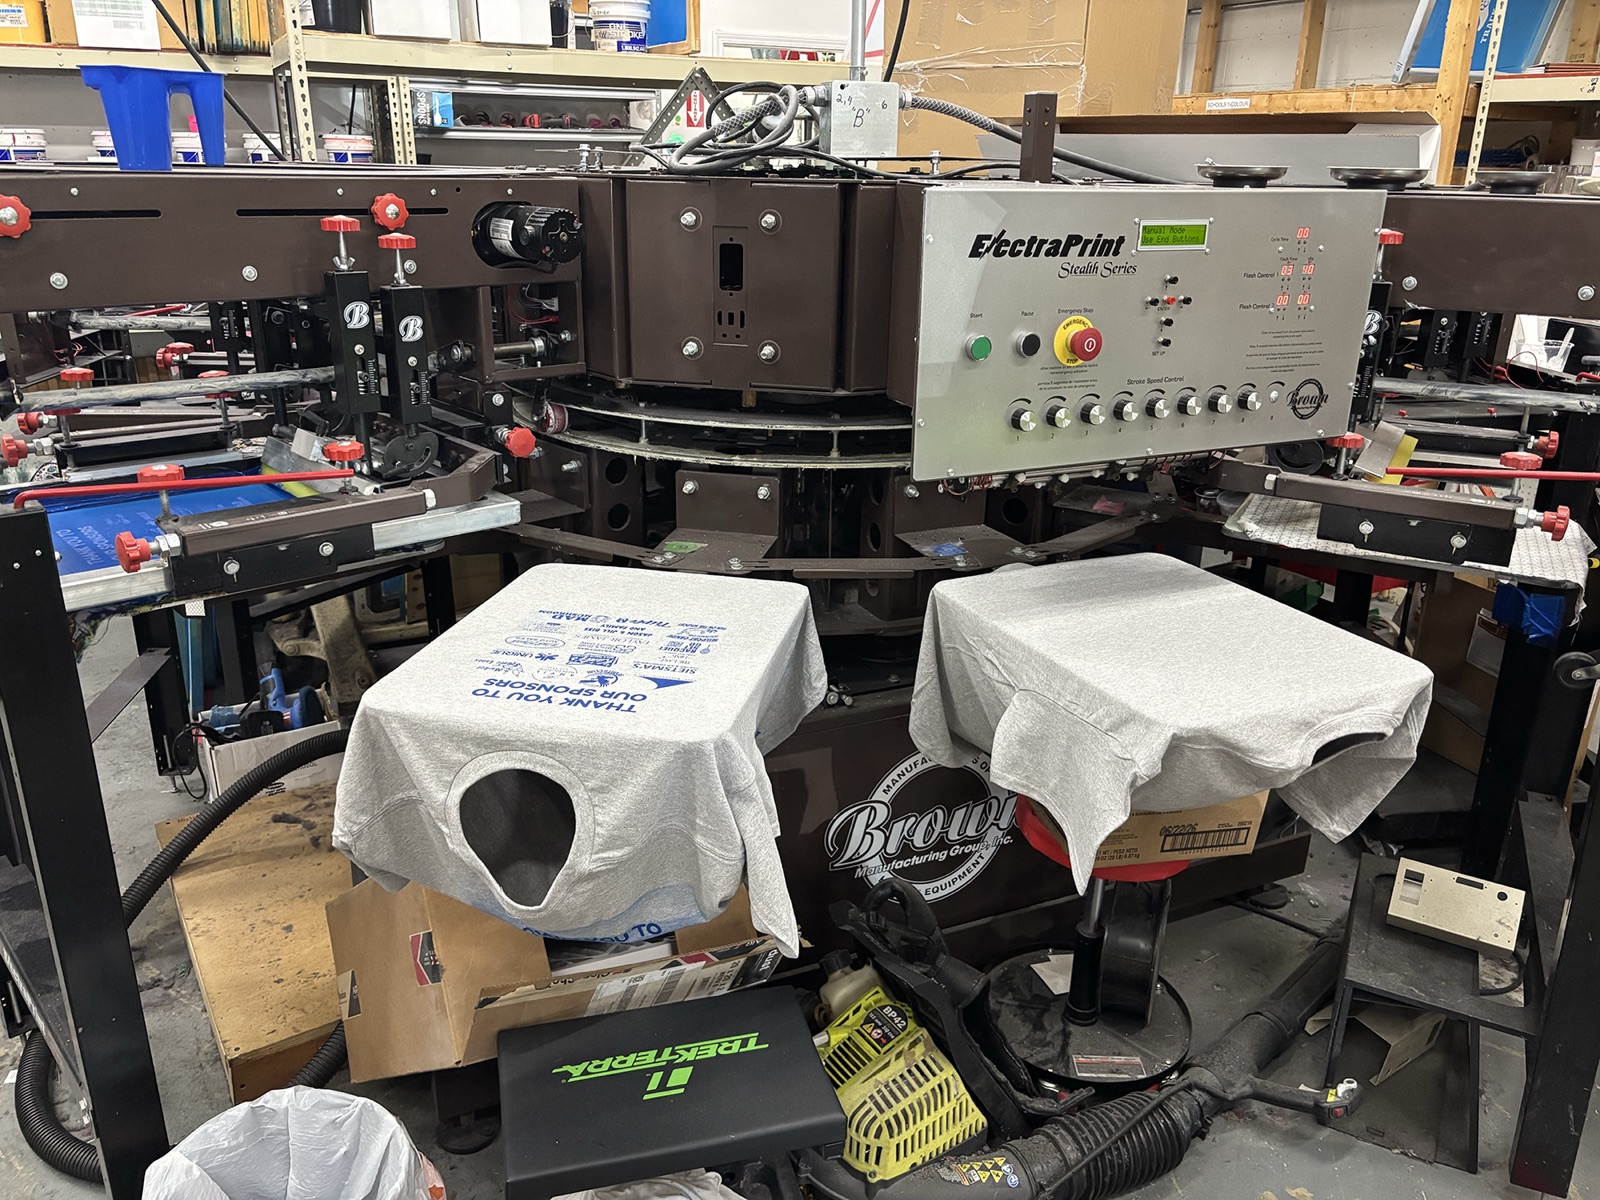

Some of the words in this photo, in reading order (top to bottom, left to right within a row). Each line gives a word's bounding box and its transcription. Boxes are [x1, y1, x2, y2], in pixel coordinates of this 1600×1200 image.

[416, 92, 426, 125] SPOONS
[1143, 226, 1165, 234] Manual
[1297, 227, 1310, 239] 00
[968, 229, 1125, 261] ElectraPrint
[1058, 262, 1098, 278] Stealth
[1100, 262, 1137, 278] Series
[1281, 265, 1294, 276] 03
[1276, 295, 1289, 306] 00
[1297, 294, 1310, 304] 00
[344, 301, 370, 328] B
[399, 315, 424, 342] B
[1149, 377, 1163, 385] Speed
[472, 688, 500, 698] TO
[484, 678, 596, 697] SPONSORS
[506, 692, 553, 704] YOU
[600, 690, 647, 701] OUR
[559, 698, 636, 713] THANK
[855, 850, 949, 878] Manufacturing
[949, 840, 991, 857] Group,
[992, 835, 1014, 848] Inc.
[924, 853, 985, 896] EQUIPMENT
[632, 923, 662, 937] TO
[882, 1005, 906, 1028] BP42
[552, 1032, 769, 1083] TREKTERRA
